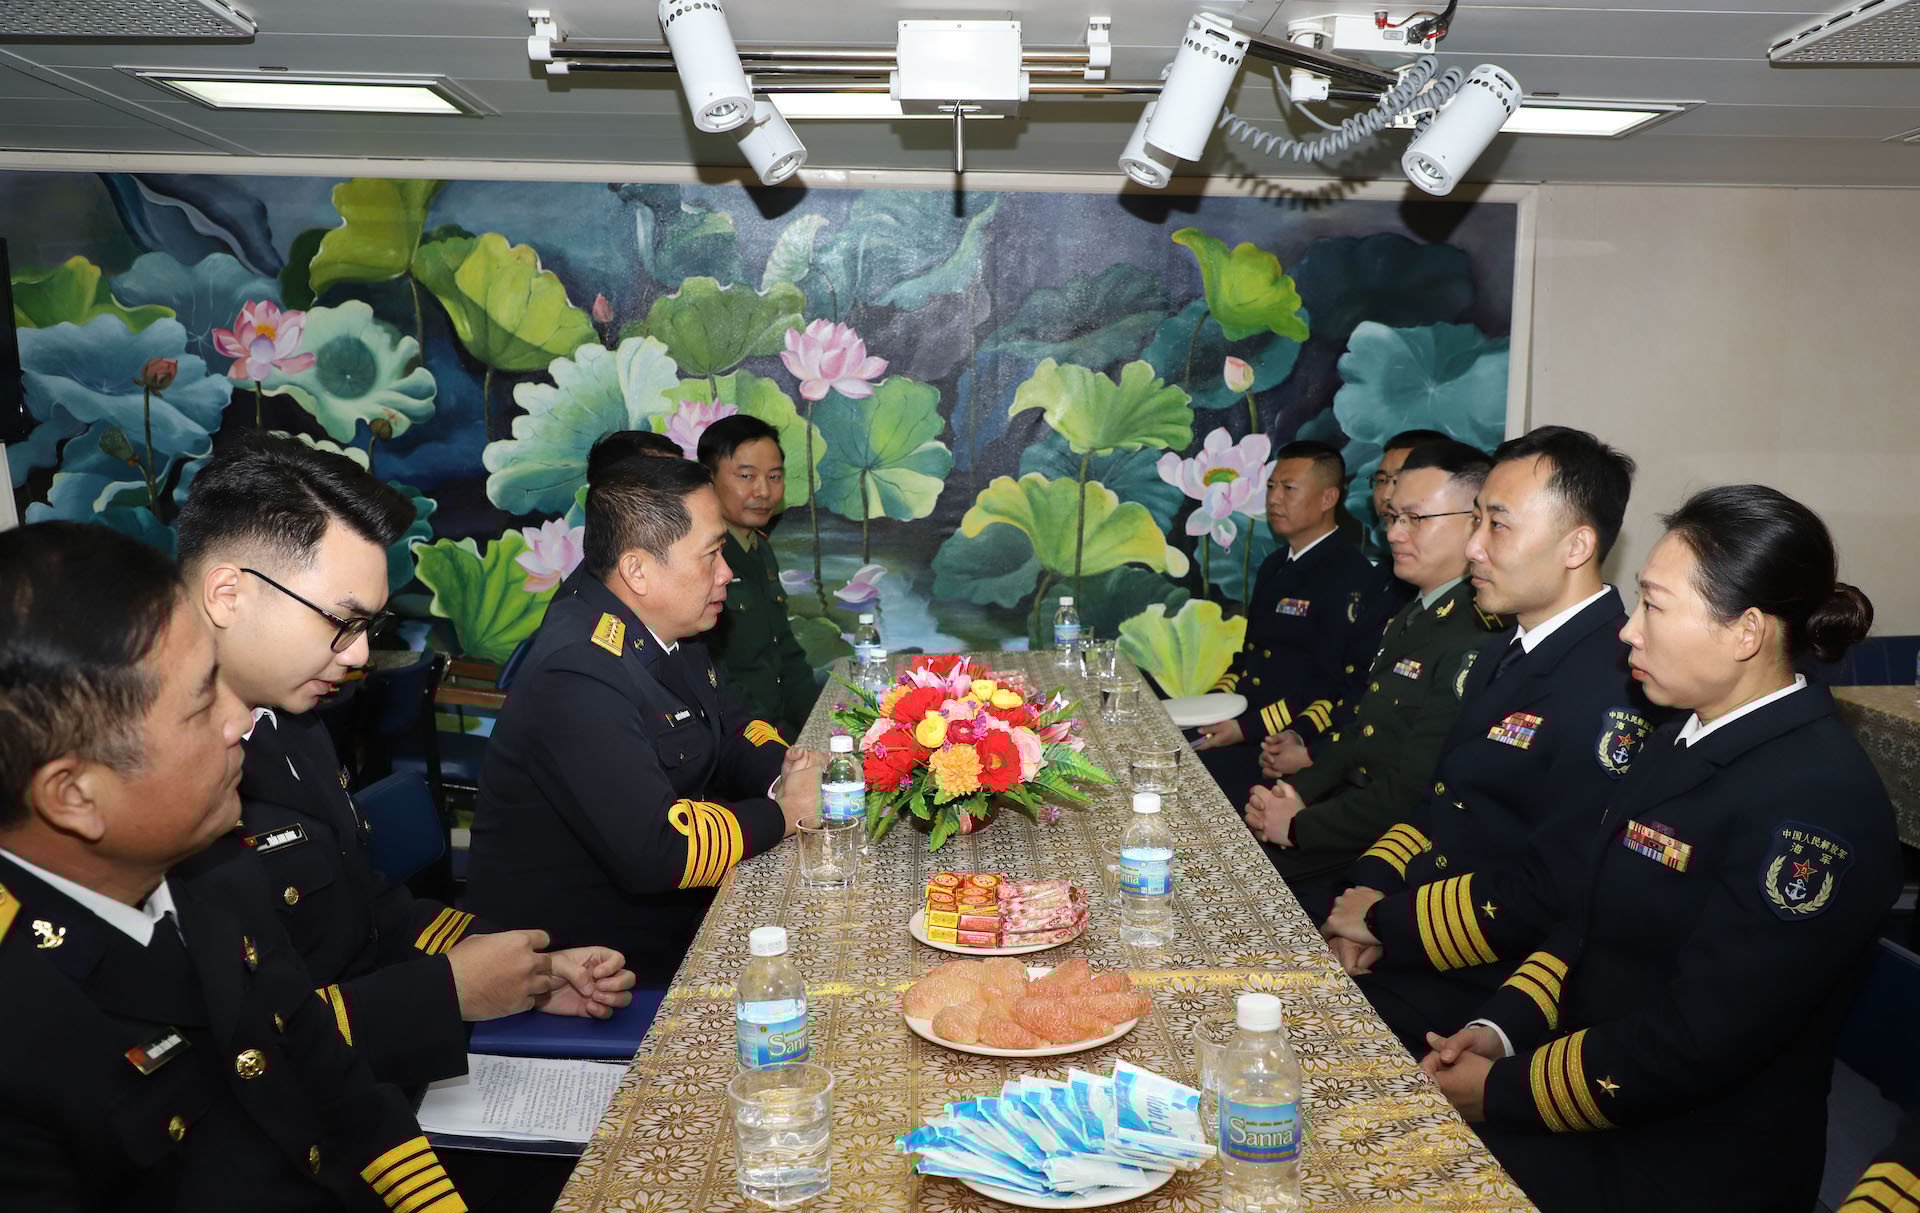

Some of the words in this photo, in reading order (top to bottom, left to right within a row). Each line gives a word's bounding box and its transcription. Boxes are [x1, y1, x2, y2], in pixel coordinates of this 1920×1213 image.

[1782, 829, 1848, 860] 中国人民解放军
[1229, 1116, 1294, 1147] Sanna
